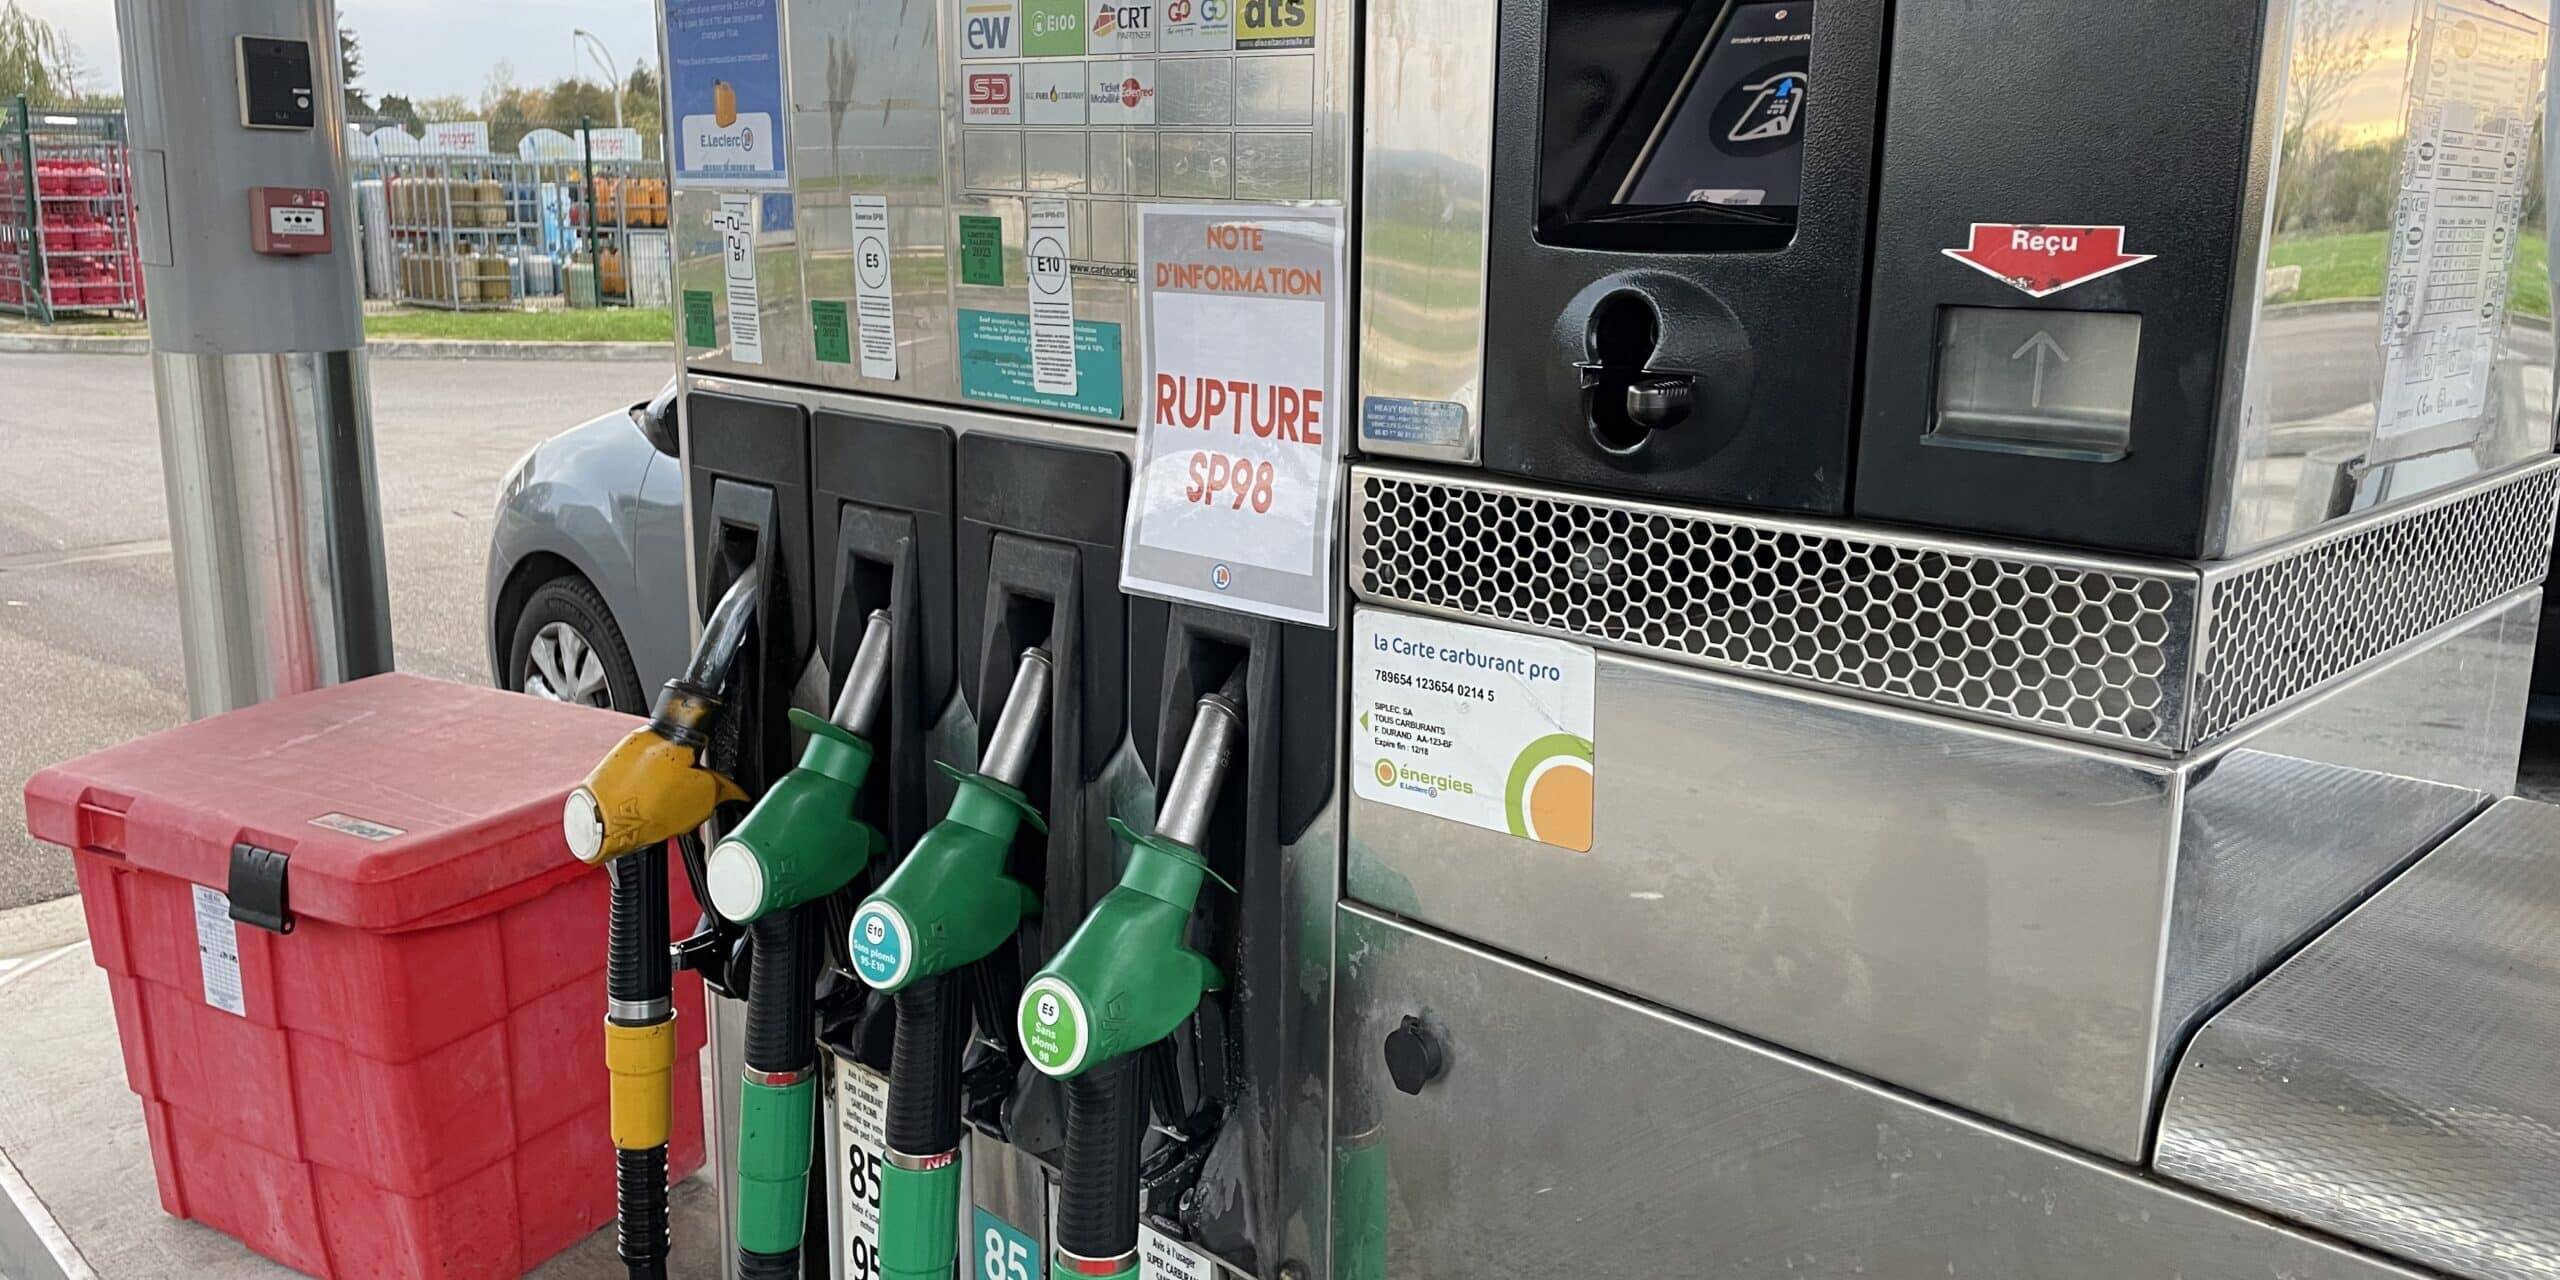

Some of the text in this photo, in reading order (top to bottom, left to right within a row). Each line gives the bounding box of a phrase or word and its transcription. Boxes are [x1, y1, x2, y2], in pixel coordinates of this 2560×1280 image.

[1117, 6, 1151, 29] CRT
[967, 16, 1011, 49] ew
[700, 133, 741, 148] E.Leclerc
[1206, 224, 1264, 252] NOTE
[2011, 229, 2078, 256] Reçu
[866, 253, 879, 268] E5
[1037, 256, 1060, 272] E10
[1156, 262, 1322, 296] D'INFORMATION
[1155, 372, 1323, 445] RUPTURE
[1186, 451, 1274, 514] SP98
[1374, 633, 1560, 681] la Carte carburant pro
[1375, 669, 1495, 702] 789654 123654 0214 5
[1403, 707, 1413, 716] SA
[1375, 713, 1446, 735] TOUS CARBURANTS
[1381, 727, 1412, 740] DURAND
[1375, 737, 1395, 747] Expire
[1397, 741, 1406, 751] fin
[1400, 763, 1473, 794] énergies
[867, 923, 883, 938] E10
[860, 955, 885, 973] 95-E10
[870, 948, 896, 964] plomb
[1041, 1002, 1055, 1017] E5
[1035, 1021, 1056, 1040] Sans
[1031, 1035, 1059, 1054] plomb
[1038, 1051, 1050, 1063] 98
[849, 1143, 881, 1209] 85
[985, 1227, 1028, 1280] 85
[1152, 1237, 1165, 1250] Avis
[1166, 1244, 1171, 1255] à
[1146, 1252, 1164, 1270] SUPER
